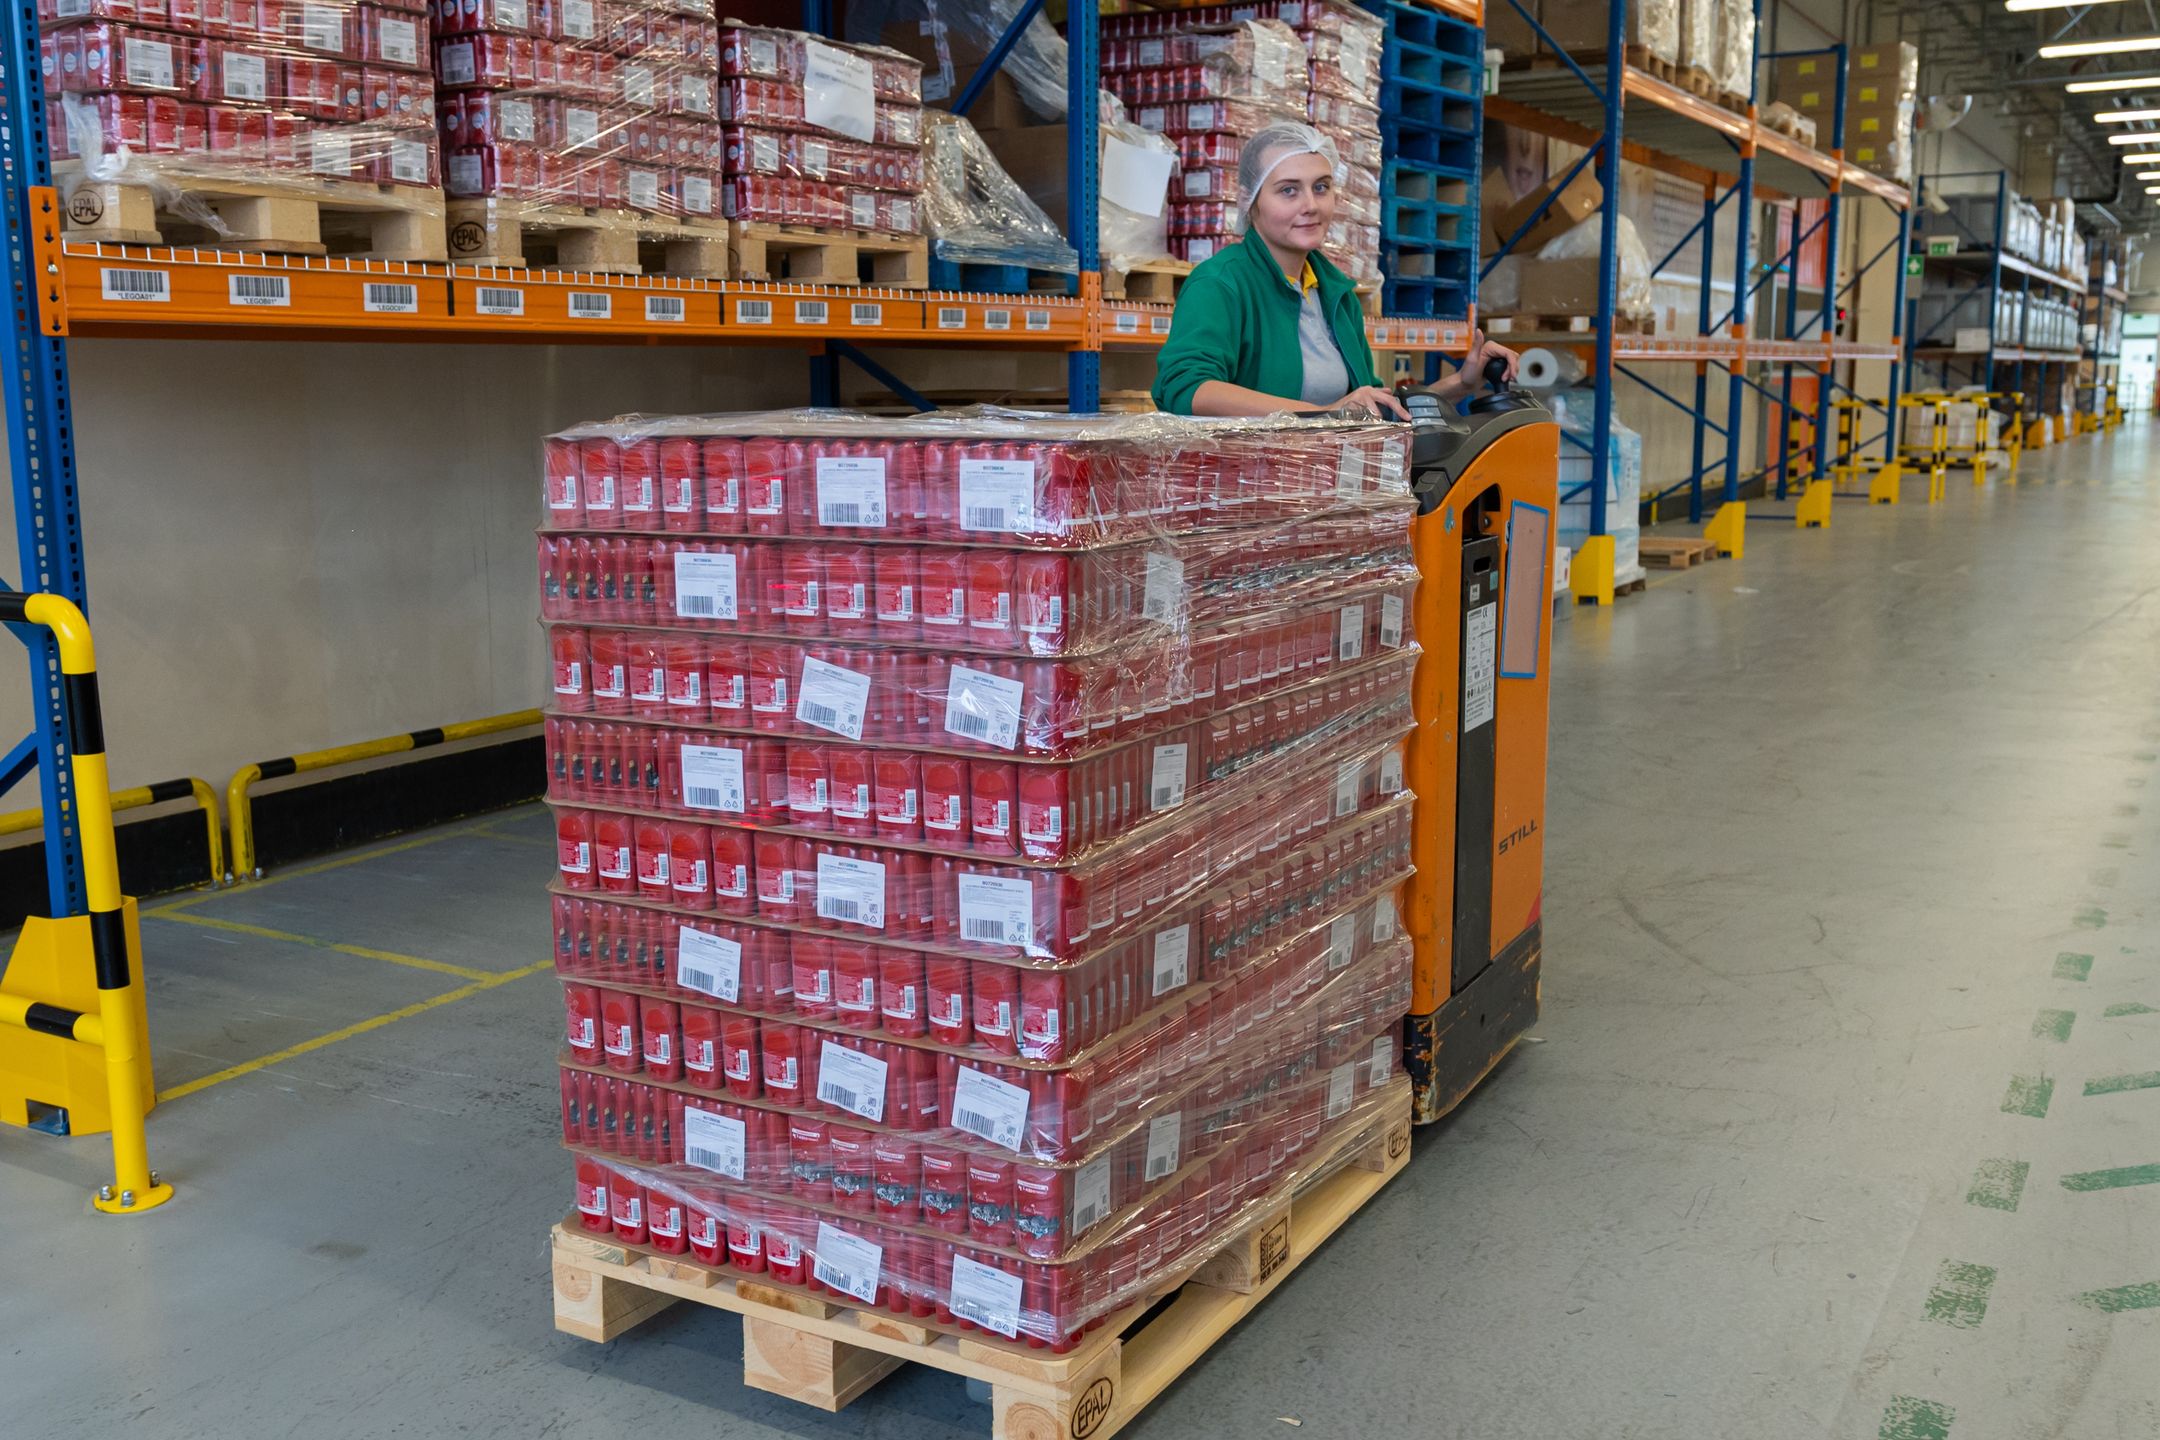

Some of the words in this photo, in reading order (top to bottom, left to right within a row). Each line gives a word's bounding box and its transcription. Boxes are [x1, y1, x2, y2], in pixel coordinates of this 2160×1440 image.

[73, 198, 99, 217] EPAL
[456, 228, 481, 246] EPAL
[1498, 819, 1538, 855] STILL
[1078, 1385, 1107, 1435] EPAL
